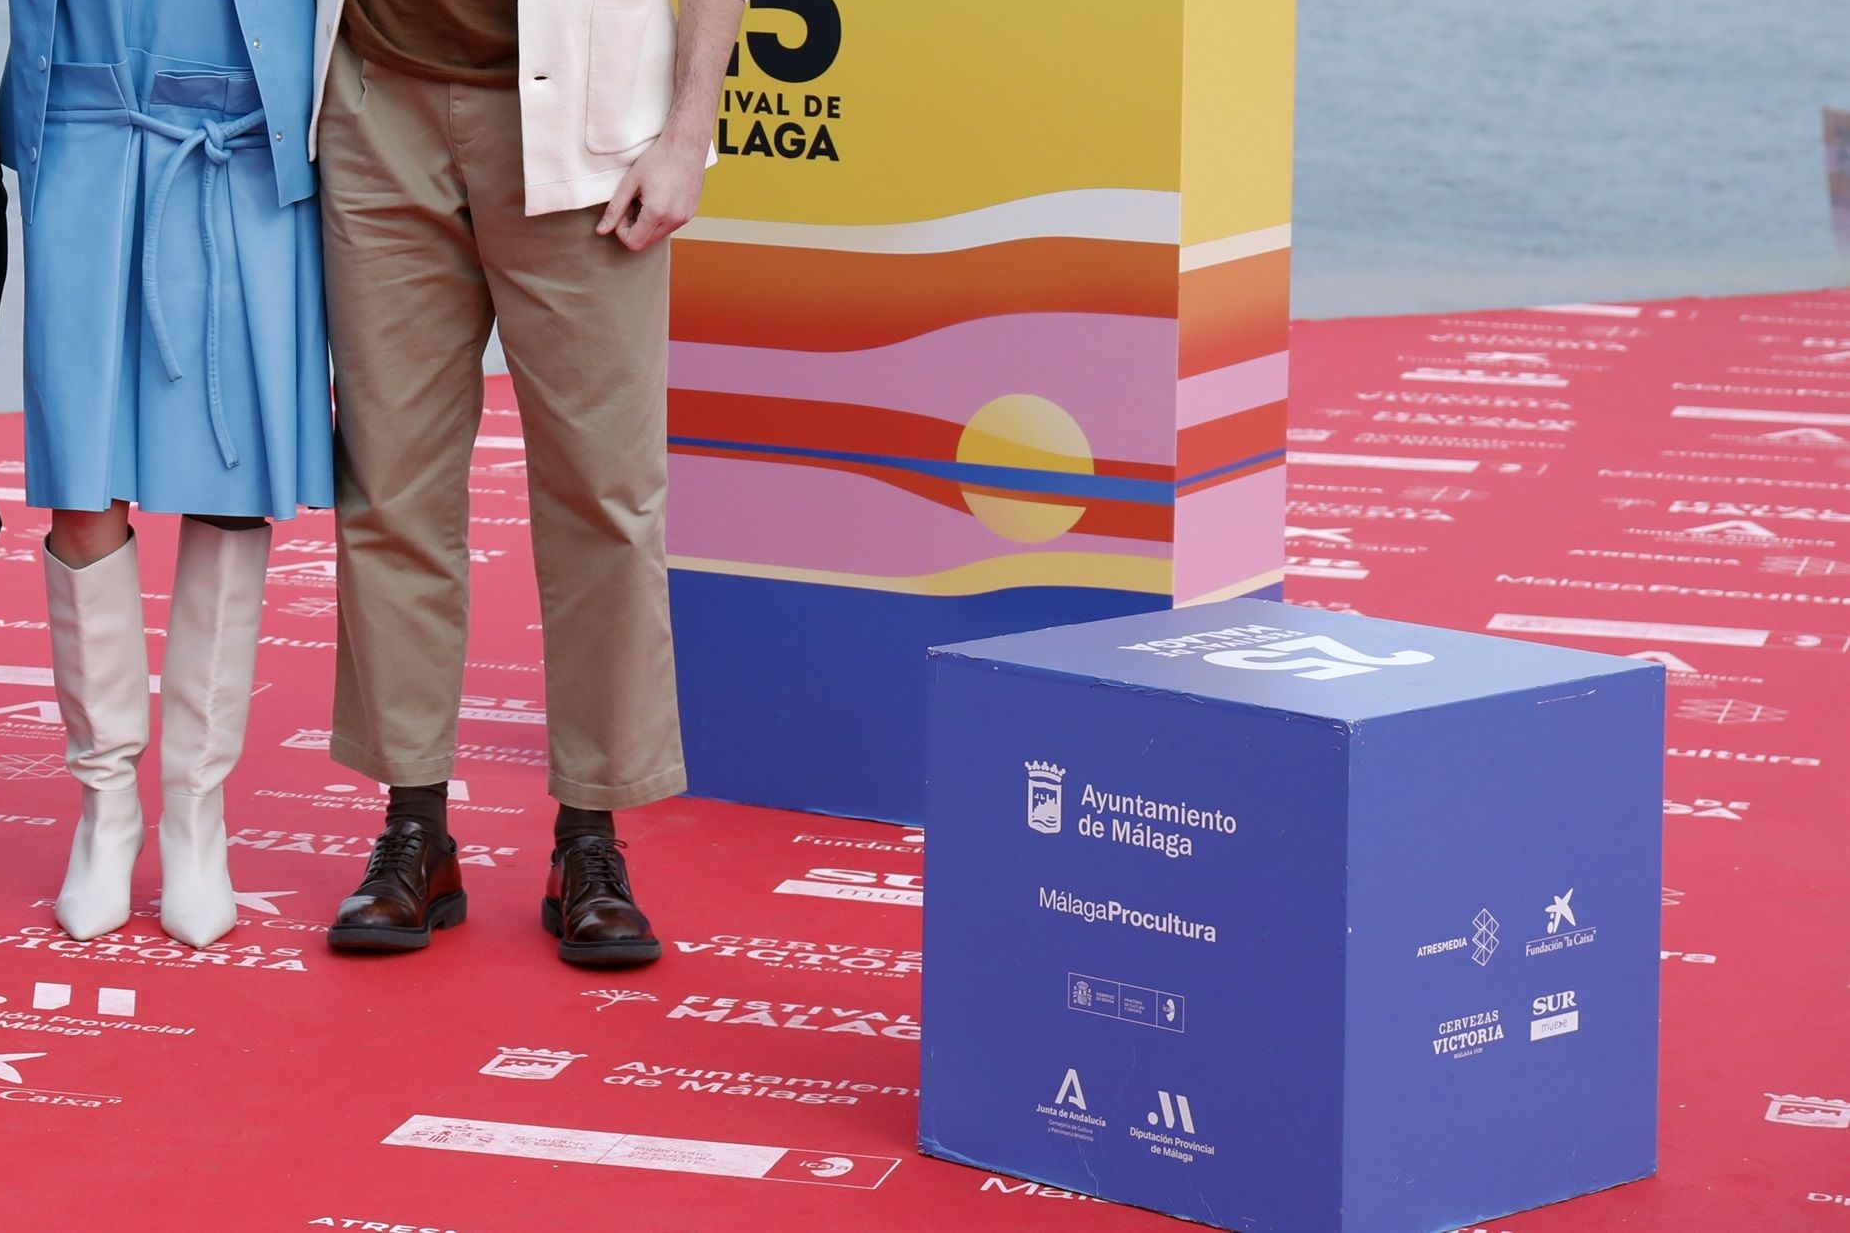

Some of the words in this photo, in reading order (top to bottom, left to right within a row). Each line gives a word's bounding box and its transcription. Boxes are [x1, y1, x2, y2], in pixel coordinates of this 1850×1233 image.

[804, 94, 841, 119] DE
[1203, 635, 1436, 680] 25
[1081, 783, 1237, 834] Ayuntamiento
[1078, 814, 1105, 838] de
[1112, 818, 1192, 858] Málaga
[461, 844, 521, 857] DE
[1039, 886, 1217, 942] MálagaProcultura
[1416, 937, 1468, 958] ATRESMEDIA
[1525, 941, 1563, 956] Fundación
[1532, 990, 1577, 1015] SUR
[53, 1015, 196, 1036] Provincial
[1439, 1010, 1499, 1035] CERVEZAS
[1432, 1024, 1504, 1055] VICTORIA
[603, 1074, 663, 1088] de
[677, 1079, 861, 1105] Málaga
[1036, 1104, 1058, 1117] Junta
[1058, 1108, 1068, 1118] de
[1069, 1110, 1106, 1127] Andalucía
[1130, 1127, 1173, 1145] Diputación
[1174, 1137, 1215, 1155] Provincial
[1151, 1144, 1162, 1154] de
[1163, 1147, 1193, 1163] Málaga
